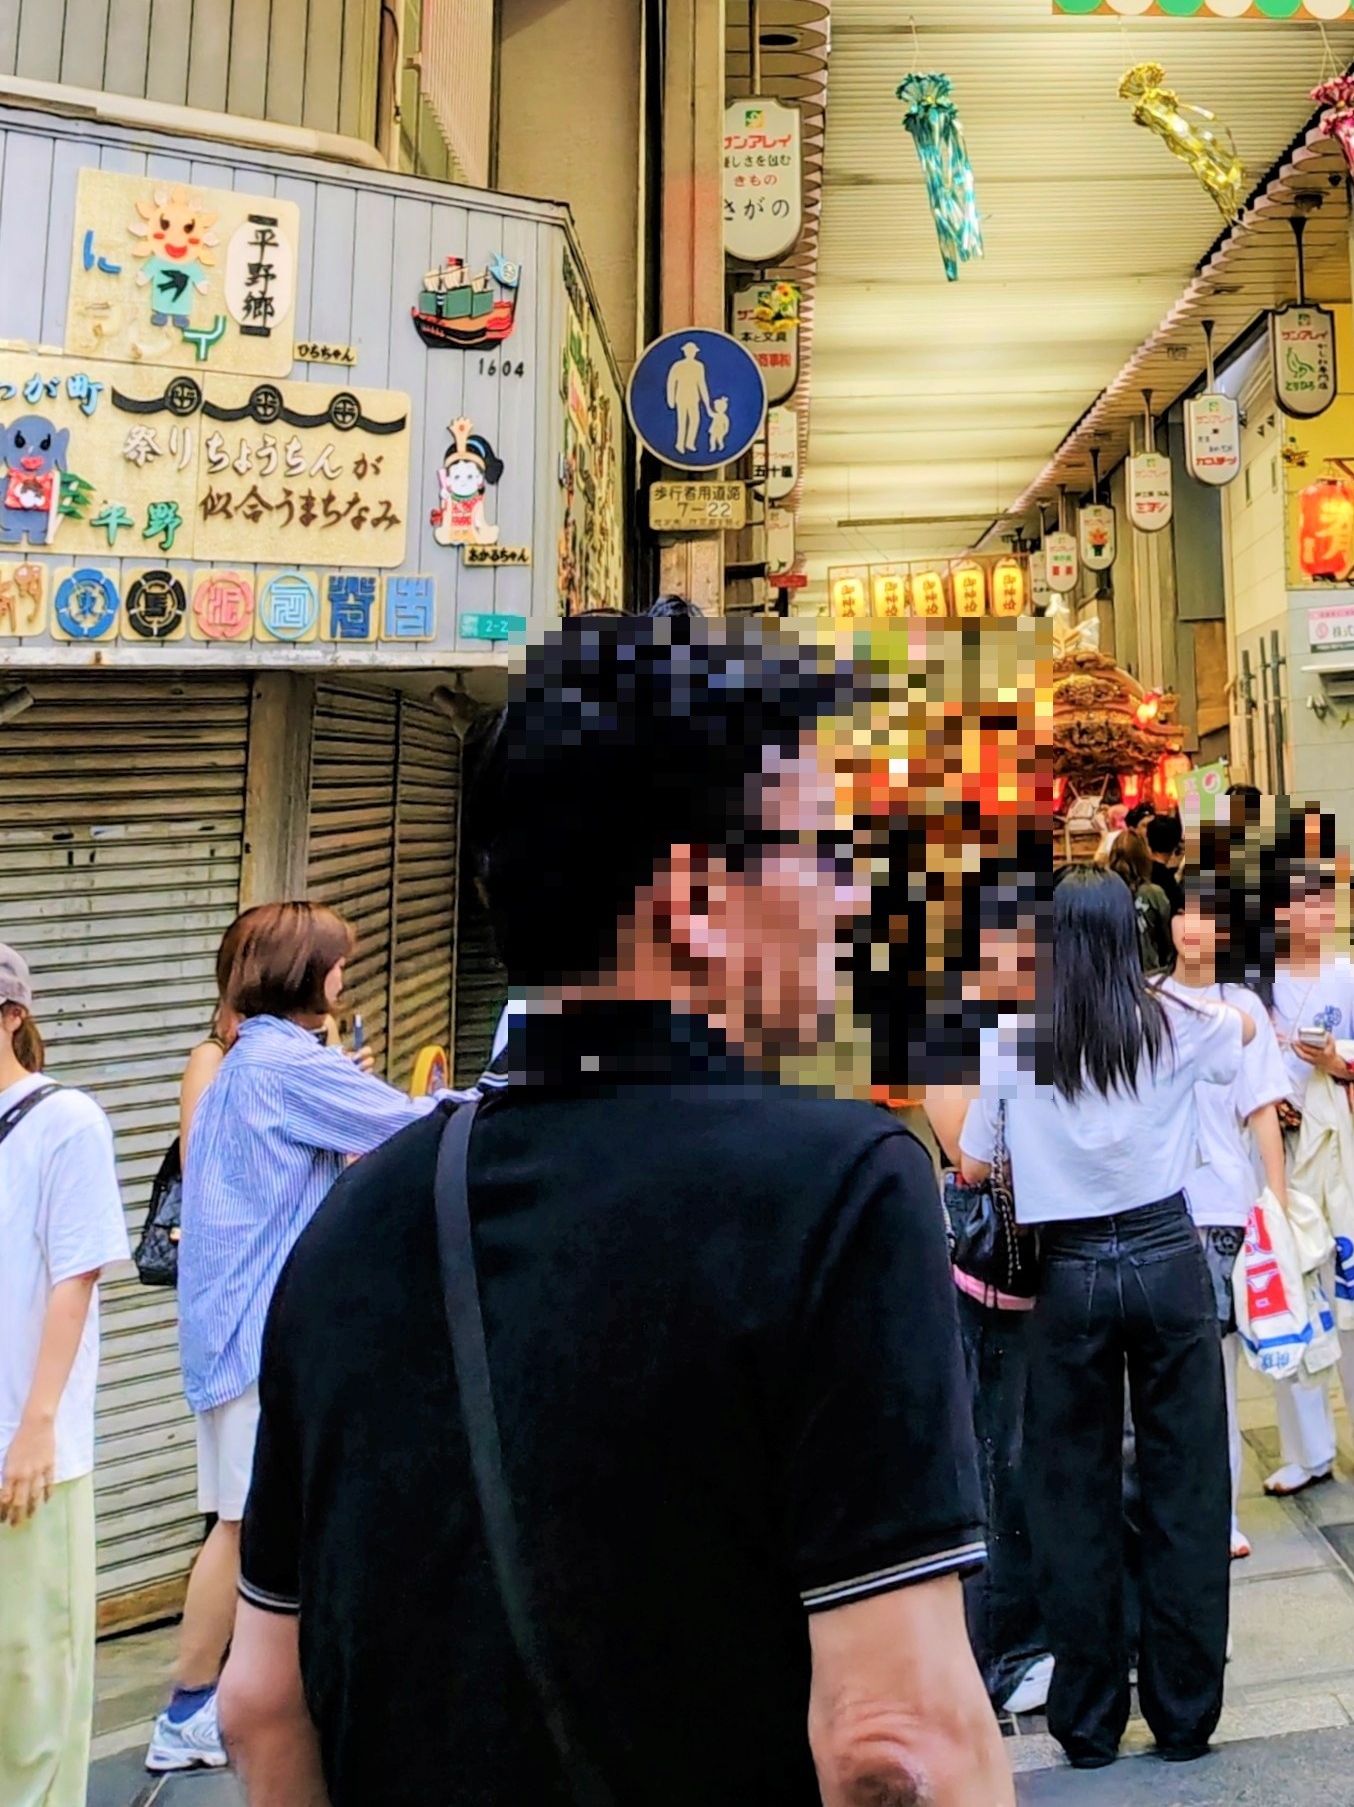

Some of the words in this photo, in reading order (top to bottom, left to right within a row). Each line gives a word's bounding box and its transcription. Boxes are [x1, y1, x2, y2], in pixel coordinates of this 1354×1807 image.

[240, 228, 280, 329] 平野郷
[477, 357, 526, 378] 1604
[199, 485, 402, 531] 似合うまちなみ
[653, 484, 742, 502] 歩行者用道路
[90, 500, 183, 551] 平野
